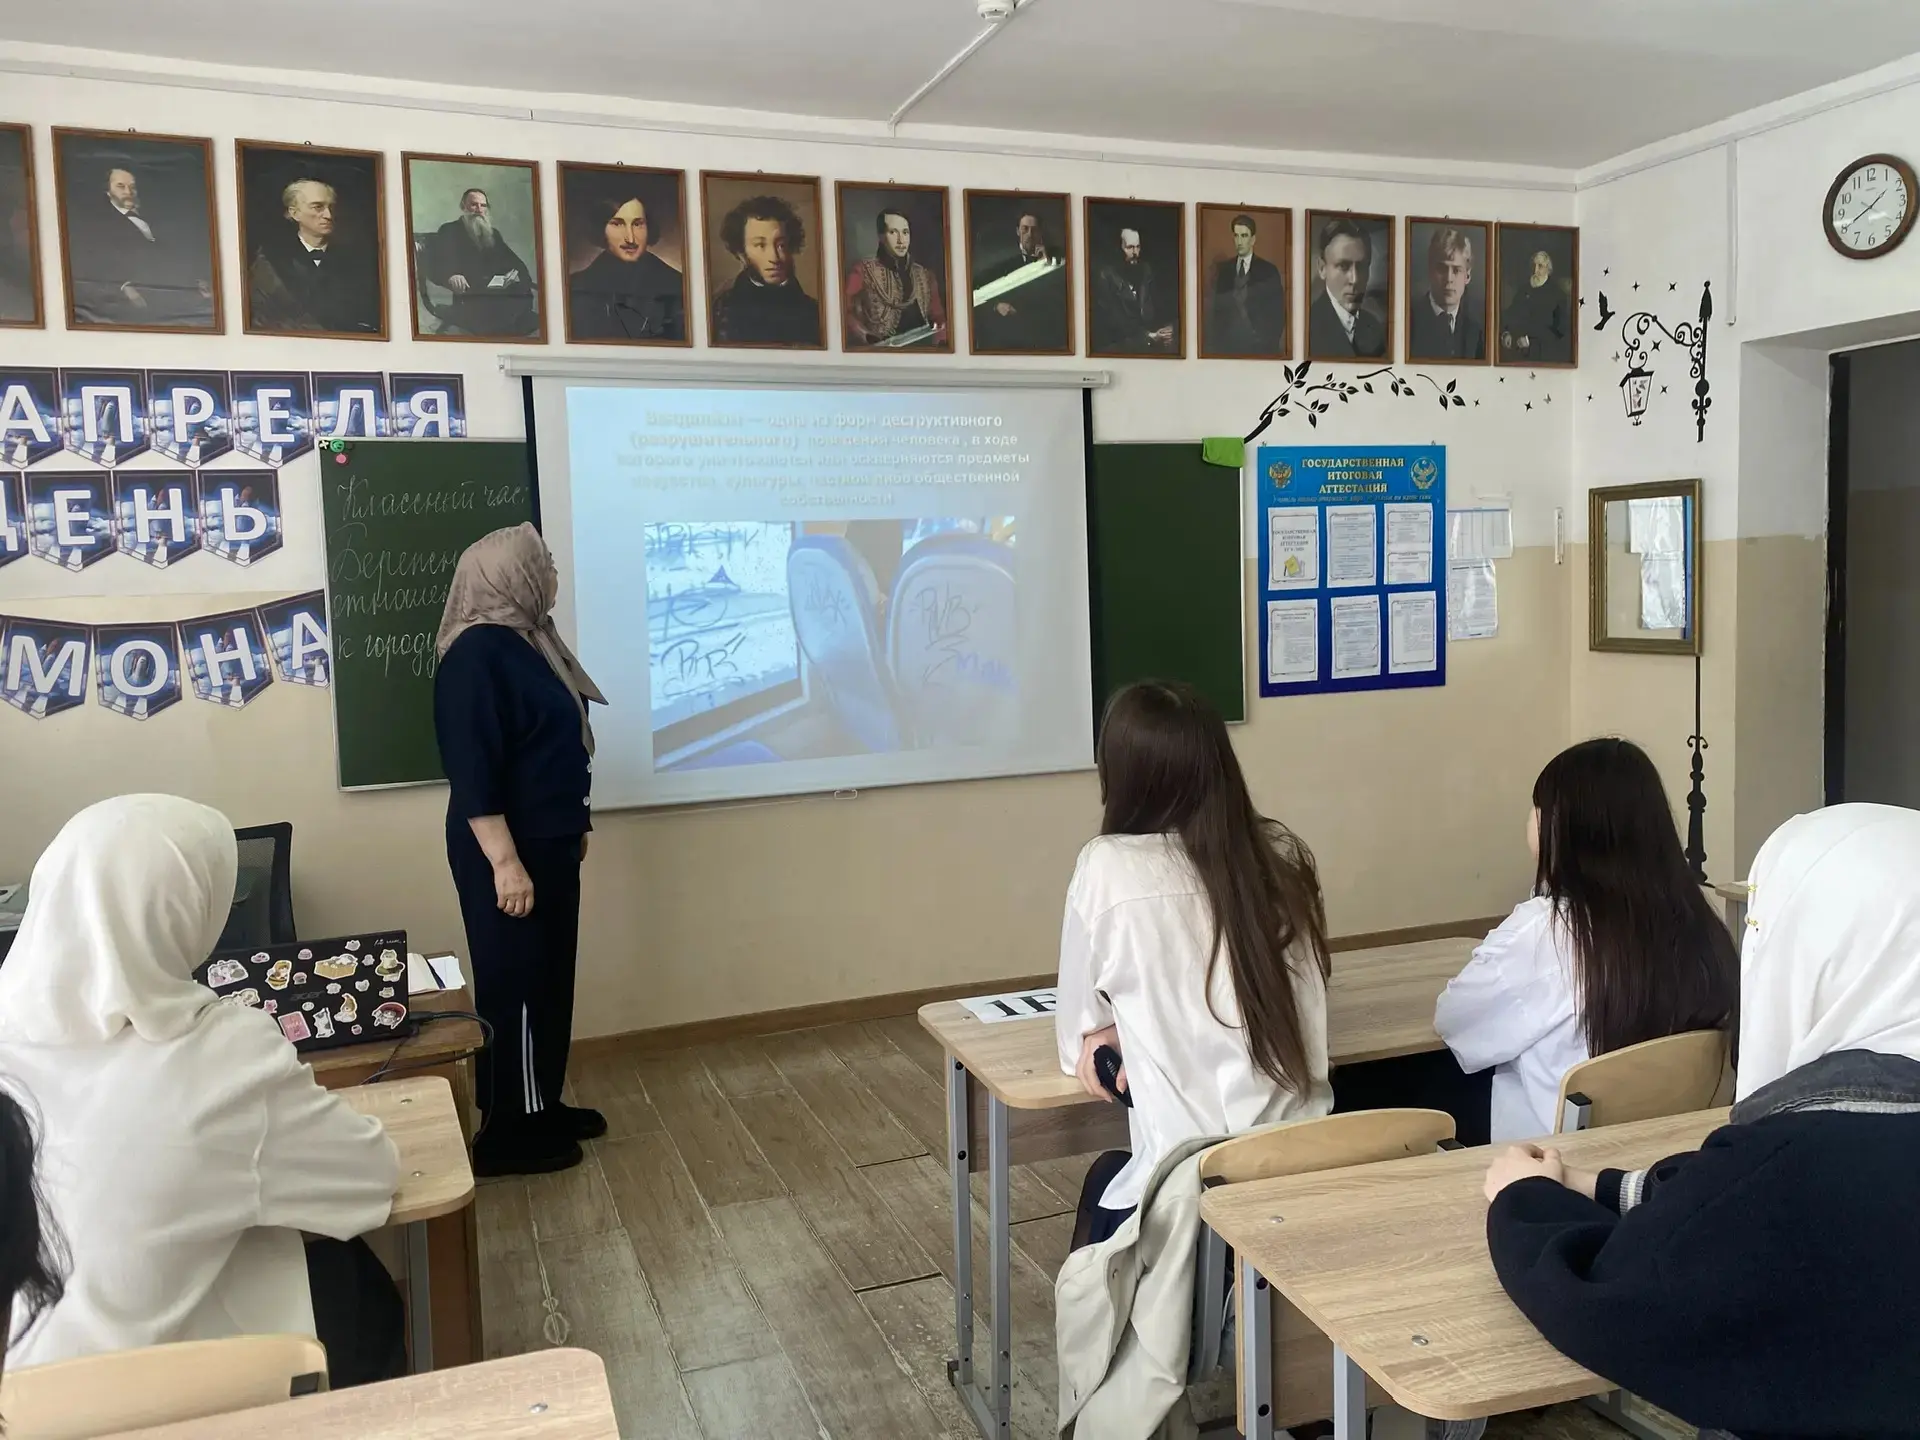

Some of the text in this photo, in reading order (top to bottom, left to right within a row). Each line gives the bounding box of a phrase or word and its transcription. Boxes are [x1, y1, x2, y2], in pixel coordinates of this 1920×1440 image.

[1866, 167, 1876, 182] 12
[1885, 168, 1889, 182] 1
[1852, 175, 1861, 190] 11
[1895, 178, 1903, 192] 2
[1841, 192, 1852, 205] 10
[1898, 194, 1906, 207] 3
[1837, 208, 1845, 220] 9
[1895, 211, 1903, 221] 4
[1840, 224, 1848, 234] 8
[1884, 224, 1892, 238] 5
[1853, 231, 1861, 246] 7
[1867, 232, 1876, 246] 6
[0, 384, 449, 443] АПРЕЛЯ
[881, 414, 1003, 430] деструктивного
[984, 434, 1018, 448] ходе
[958, 452, 1030, 466] предметы
[1301, 457, 1405, 469] ГОСУДАРСТВЕННАЯ
[914, 469, 1021, 485] общественной
[1327, 470, 1383, 480] ИТОГОВАЯ
[1318, 484, 1388, 494] АТТЕСТАЦИЯ
[337, 474, 475, 521] Классный
[338, 631, 438, 679] к городу
